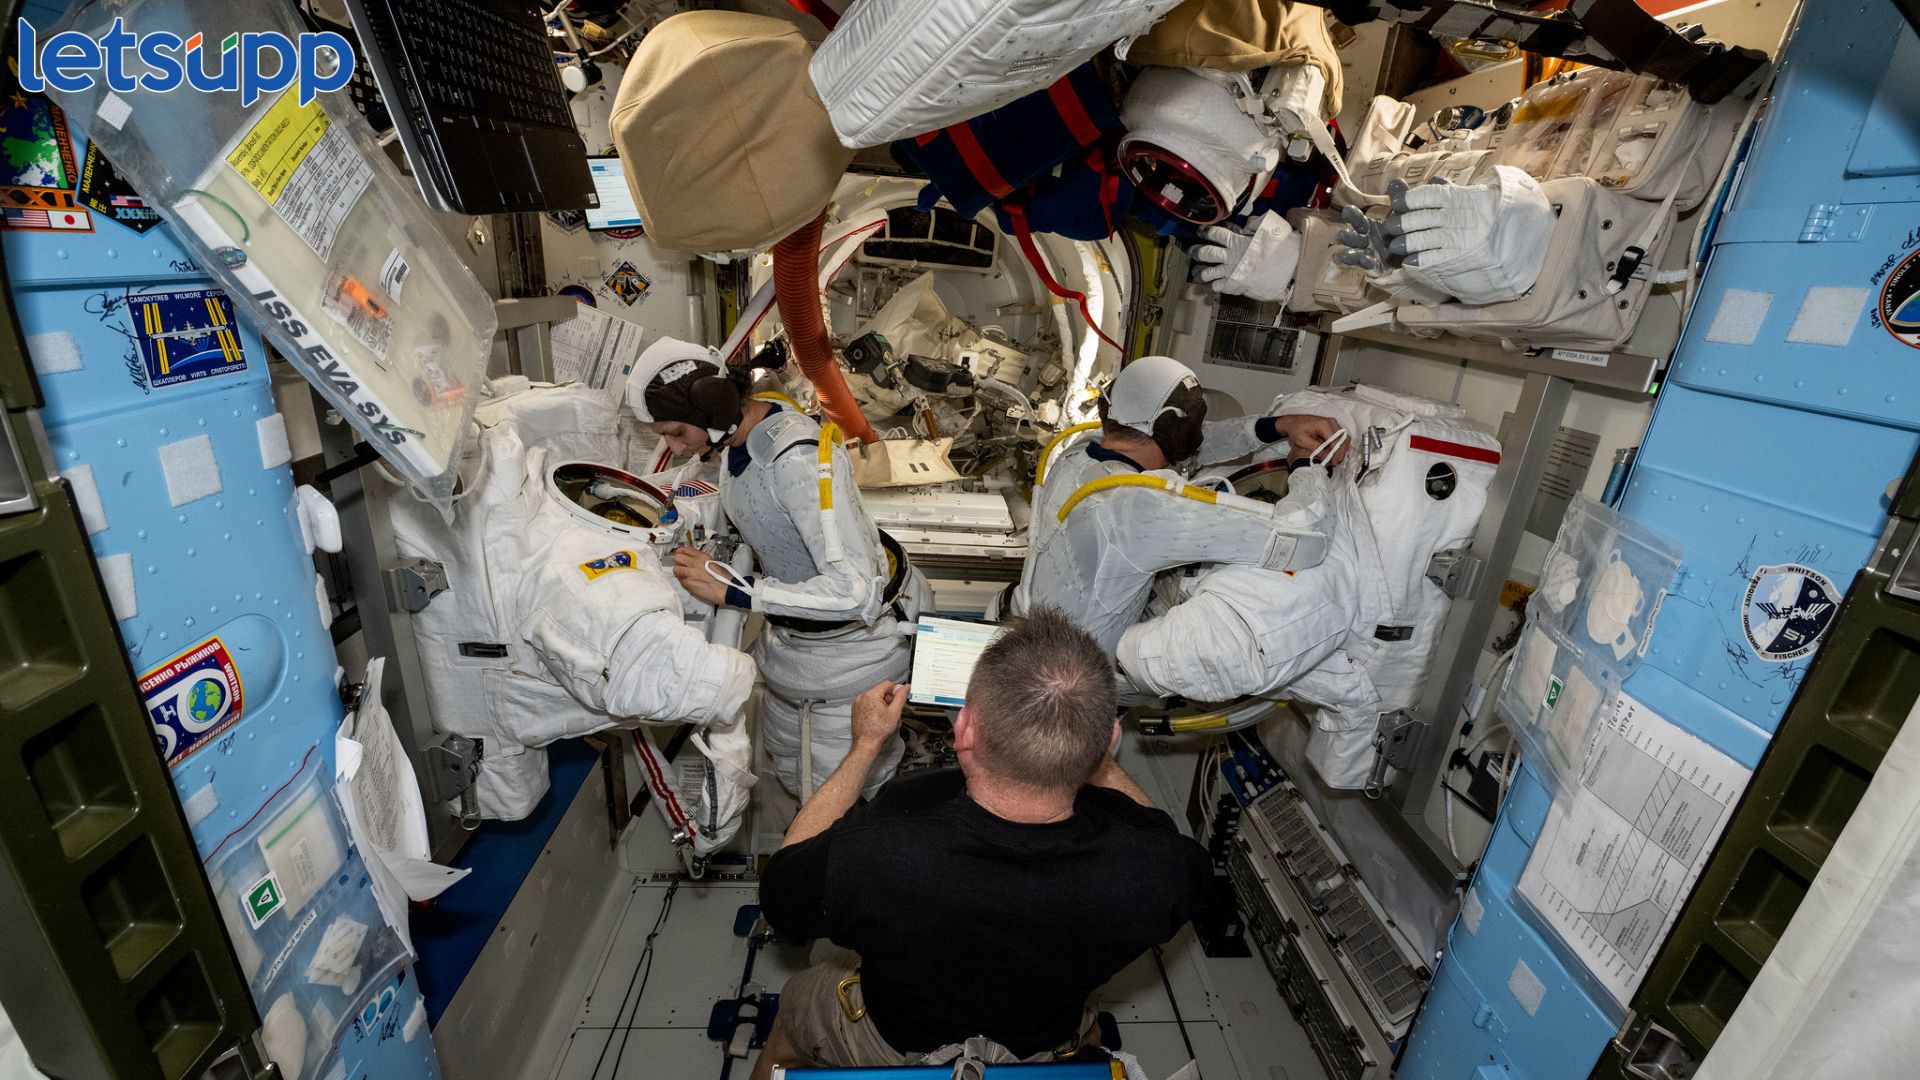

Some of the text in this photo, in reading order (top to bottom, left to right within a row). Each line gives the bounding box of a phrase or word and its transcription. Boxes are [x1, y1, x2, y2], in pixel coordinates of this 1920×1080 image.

[82, 142, 97, 194] МАЛЕНЧЕНК
[1890, 263, 1912, 287] TINGLE
[174, 291, 202, 299] WILMORE
[1884, 293, 1893, 317] KANAI
[190, 370, 207, 379] VIRTS
[254, 290, 308, 338] ISS
[304, 344, 359, 397] EVA
[357, 401, 407, 445] SYS
[1787, 566, 1827, 586] WHITSON
[1744, 575, 1761, 608] PESQUET
[1783, 628, 1806, 645] 51
[174, 641, 221, 673] РЫЖИКОВ
[1774, 647, 1809, 660] FISCHER
[223, 662, 241, 703] WHITSON
